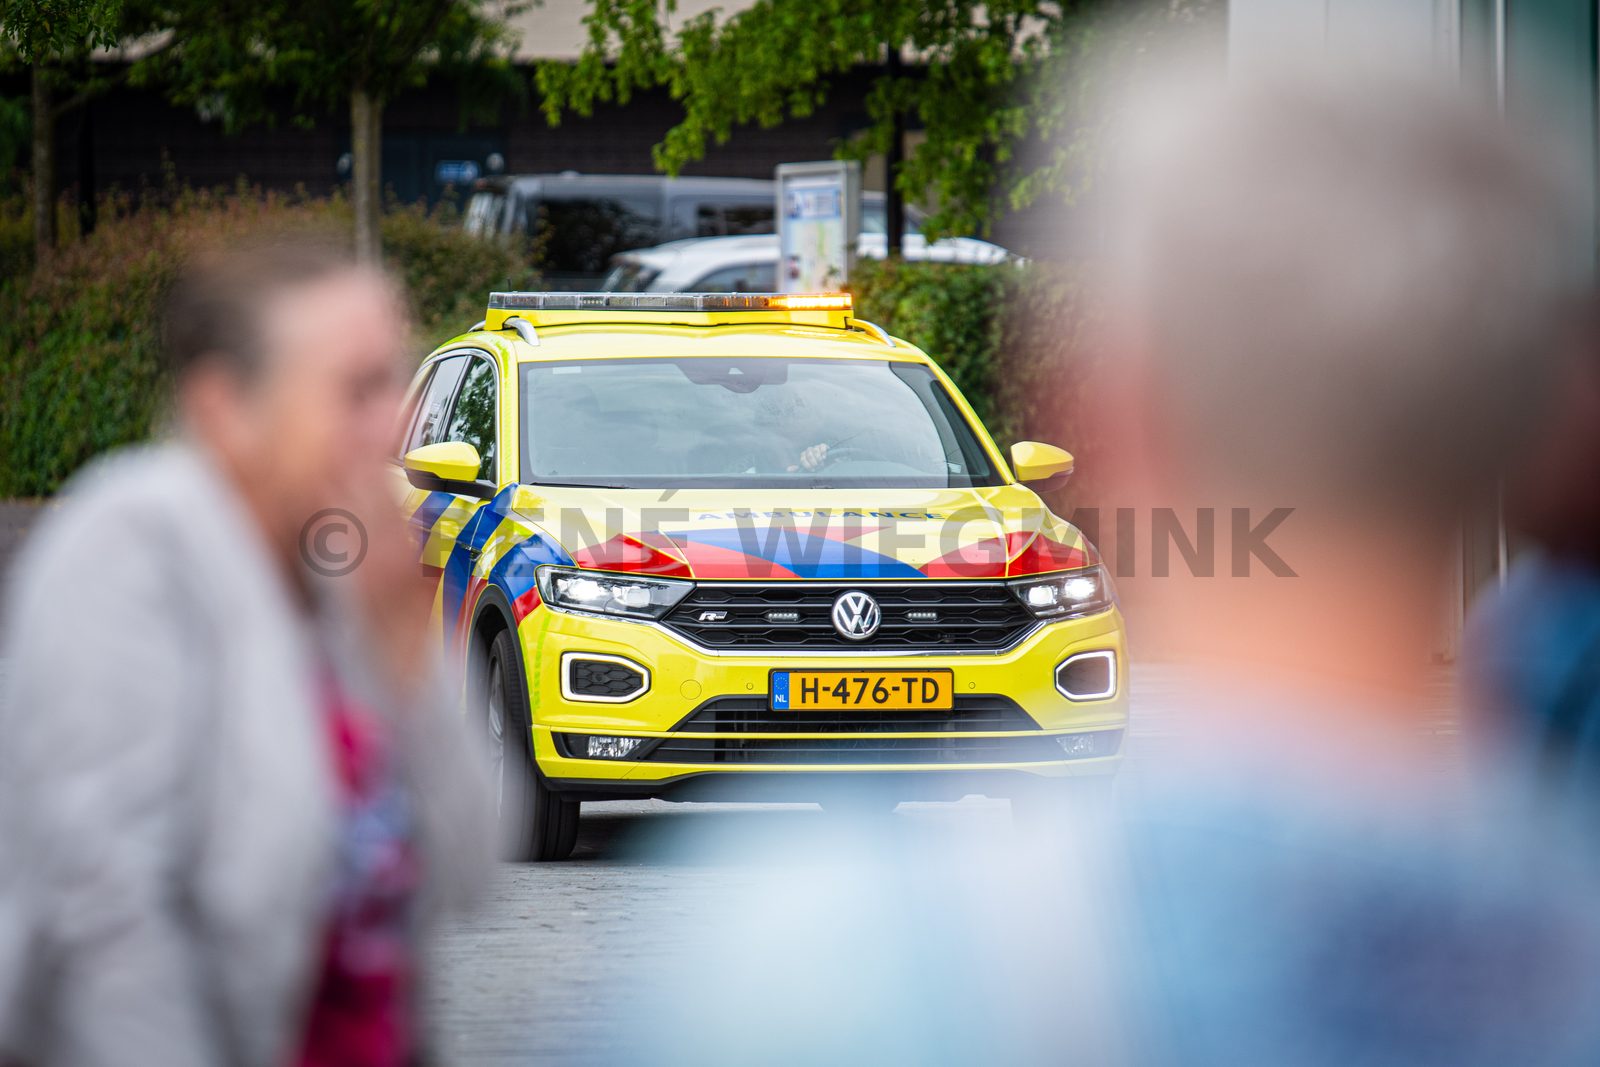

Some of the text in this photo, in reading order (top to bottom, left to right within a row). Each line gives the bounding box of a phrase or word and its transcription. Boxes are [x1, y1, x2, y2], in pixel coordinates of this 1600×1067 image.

[698, 510, 946, 521] AMBULANCE
[801, 677, 940, 704] H-476-TD
[775, 694, 787, 703] NL
